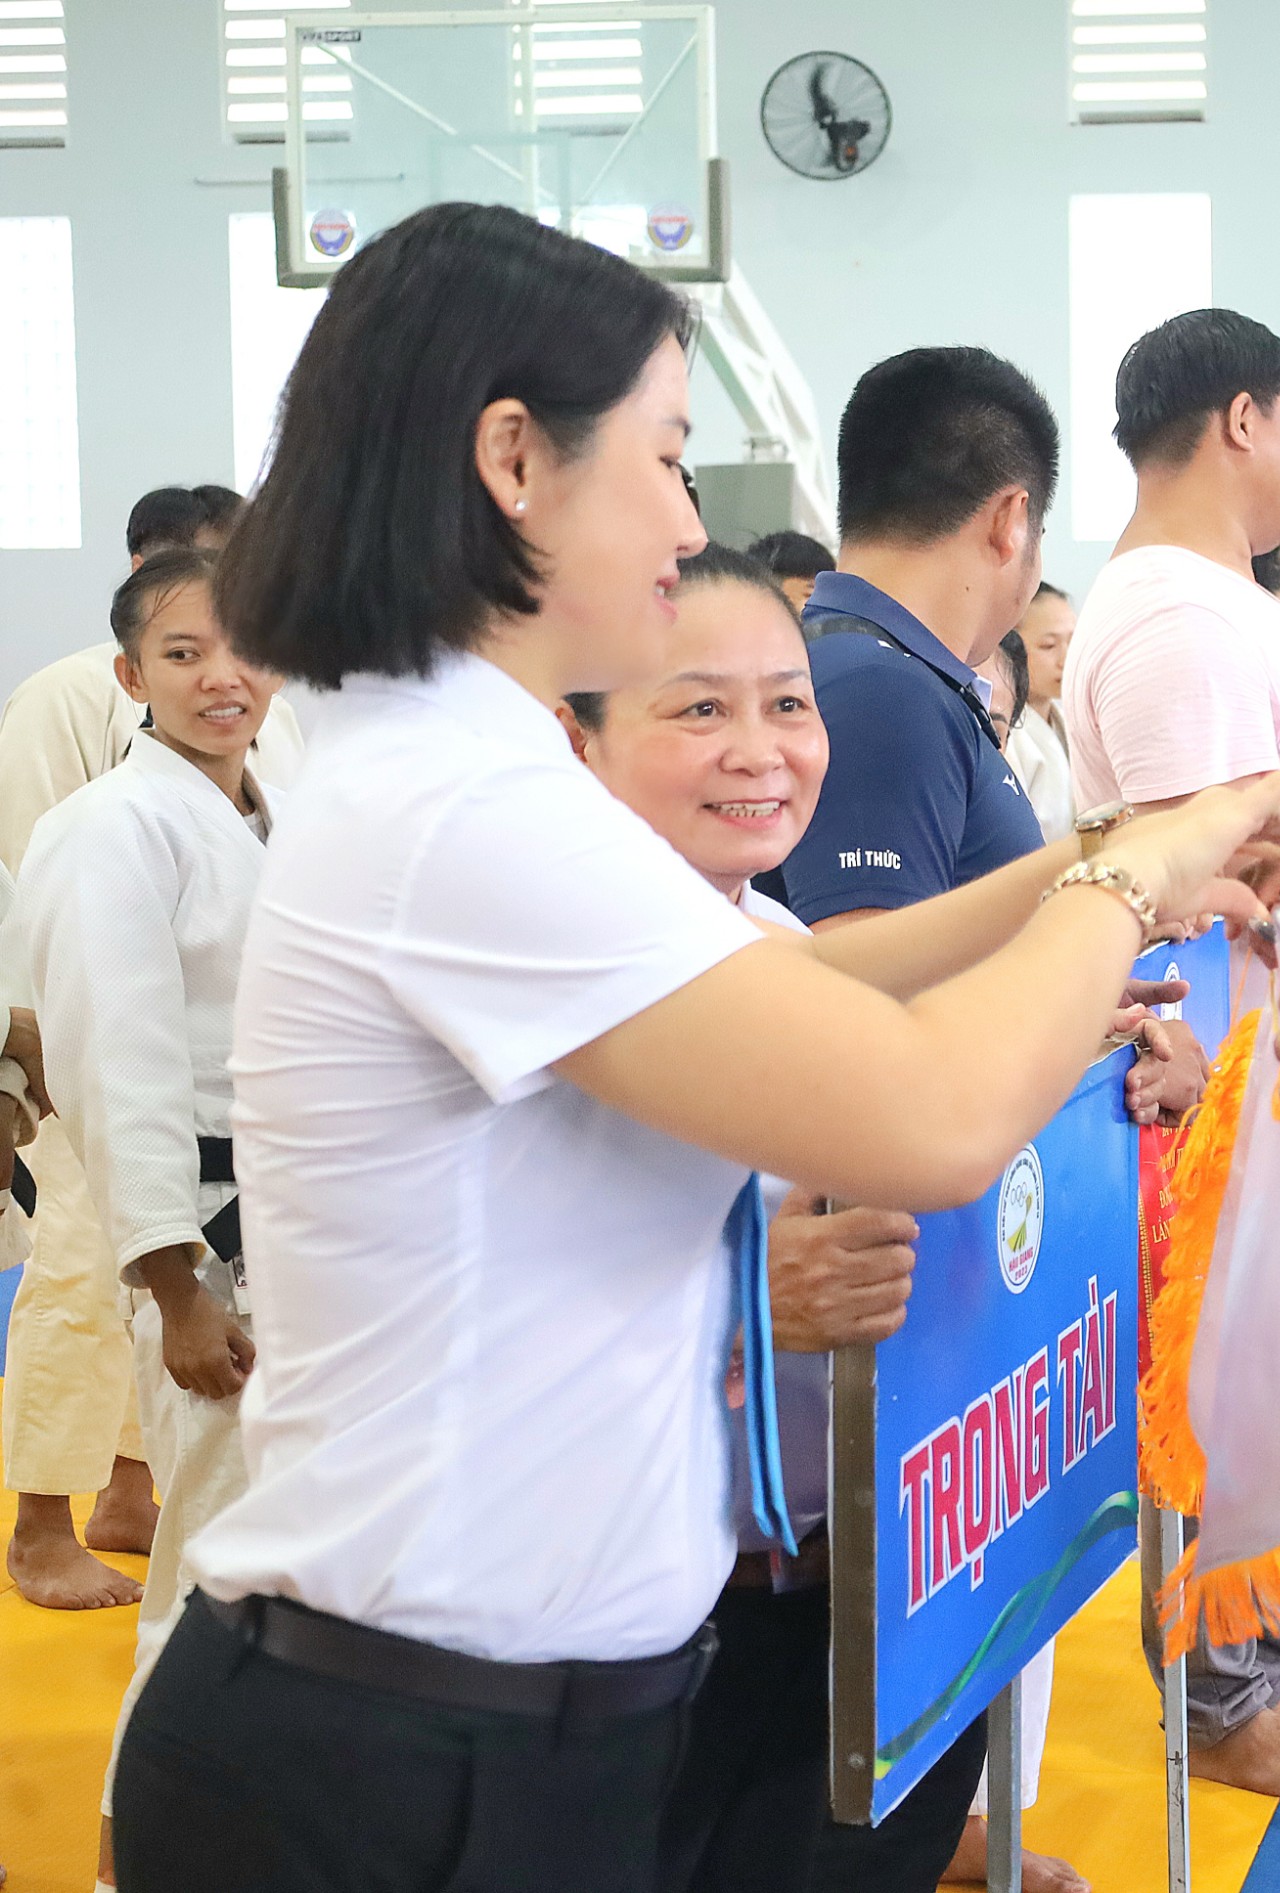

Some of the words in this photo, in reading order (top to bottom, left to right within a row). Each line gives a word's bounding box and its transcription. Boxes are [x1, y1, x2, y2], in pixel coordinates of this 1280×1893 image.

[838, 847, 862, 869] TRÍ
[864, 849, 902, 870] THỨC
[899, 1344, 1050, 1620] TRỌNG
[1056, 1273, 1118, 1477] TẢI
